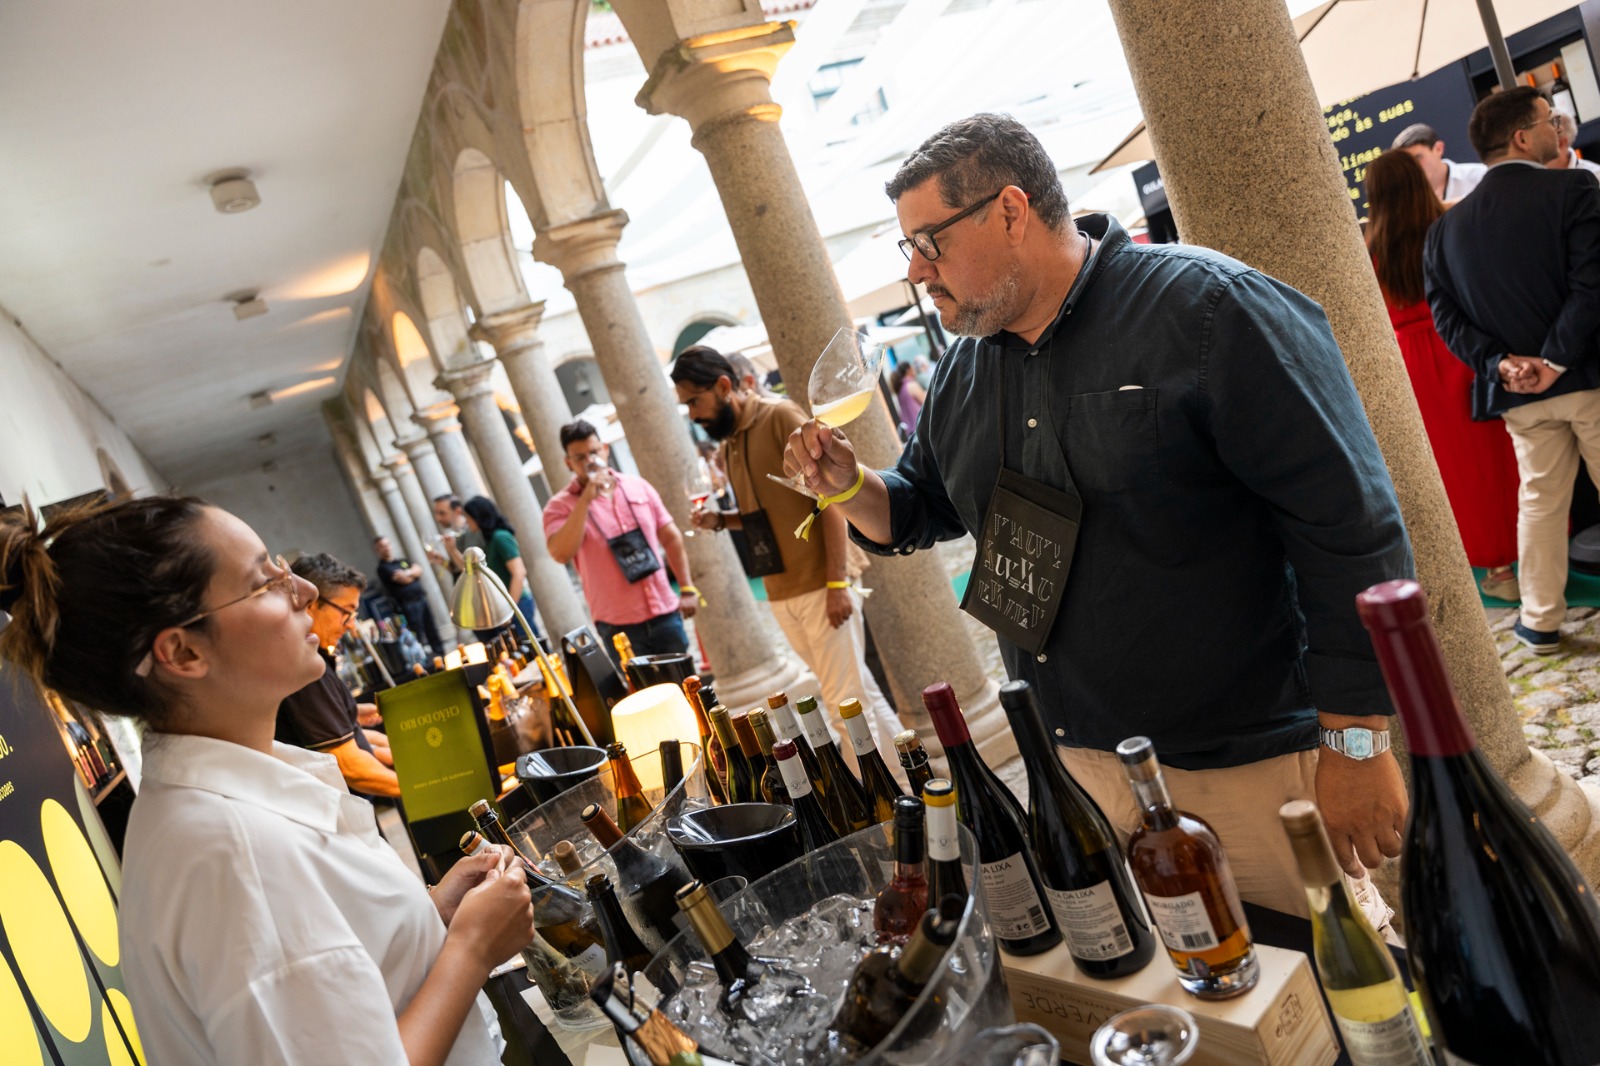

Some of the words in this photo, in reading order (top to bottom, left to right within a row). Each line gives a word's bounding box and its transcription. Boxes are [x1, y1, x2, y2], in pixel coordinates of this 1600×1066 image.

[1325, 108, 1359, 128] aça,
[1331, 126, 1350, 142] do
[1378, 99, 1414, 123] suas
[1341, 146, 1382, 171] linas
[399, 718, 417, 731] RIO
[418, 713, 432, 726] DO
[991, 861, 1012, 873] LIXA
[1063, 892, 1075, 900] DA
[1075, 889, 1095, 899] LIXA
[1021, 991, 1107, 1025] VERDE
